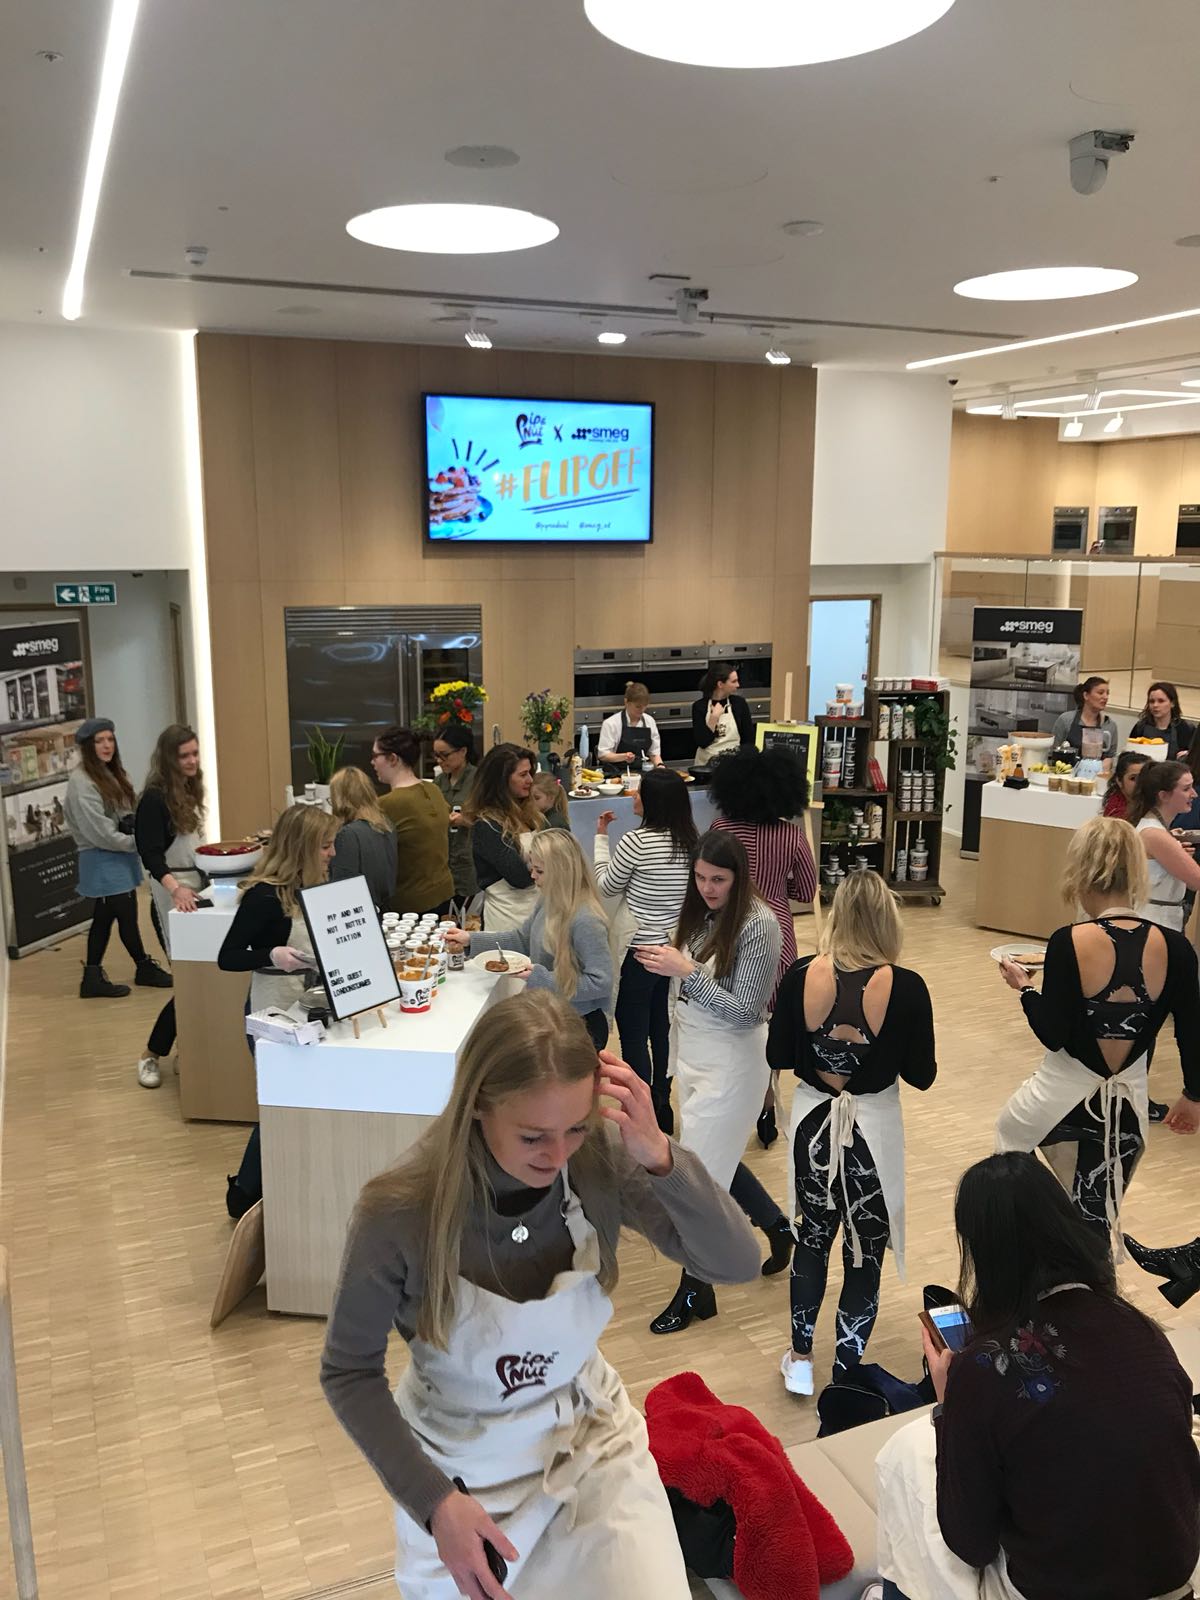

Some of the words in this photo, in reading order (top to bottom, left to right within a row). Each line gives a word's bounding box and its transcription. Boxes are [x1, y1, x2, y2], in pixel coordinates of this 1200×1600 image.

[592, 428, 629, 441] smeg
[497, 447, 641, 503] #FLIPOFF
[95, 586, 110, 594] Fire
[1019, 620, 1054, 633] smeg
[29, 638, 59, 652] smeg
[341, 909, 351, 918] AND
[353, 905, 364, 914] NUT
[327, 925, 338, 934] NUT
[345, 917, 366, 929] BUTTER
[336, 931, 362, 944] STATION
[347, 970, 362, 981] GUEST
